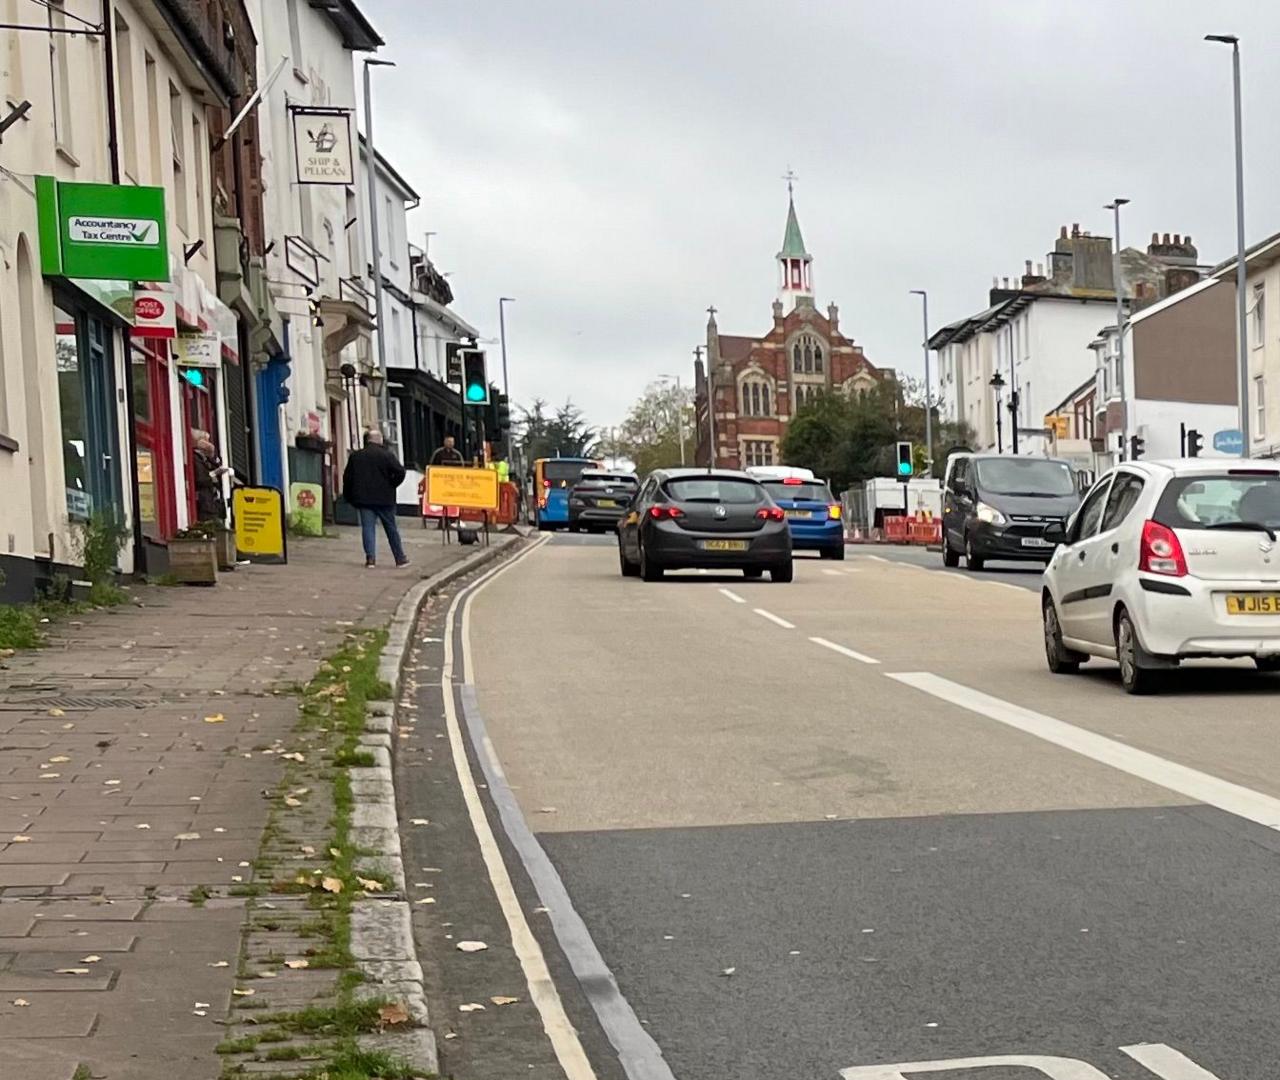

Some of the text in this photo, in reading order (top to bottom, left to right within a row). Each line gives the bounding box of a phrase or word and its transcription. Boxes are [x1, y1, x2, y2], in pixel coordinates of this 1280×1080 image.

[307, 157, 341, 167] SHIP &
[304, 166, 346, 177] PELICAN
[74, 218, 137, 231] Accountancy
[82, 230, 131, 241] Tax Centre
[1237, 595, 1271, 612] WJ15
